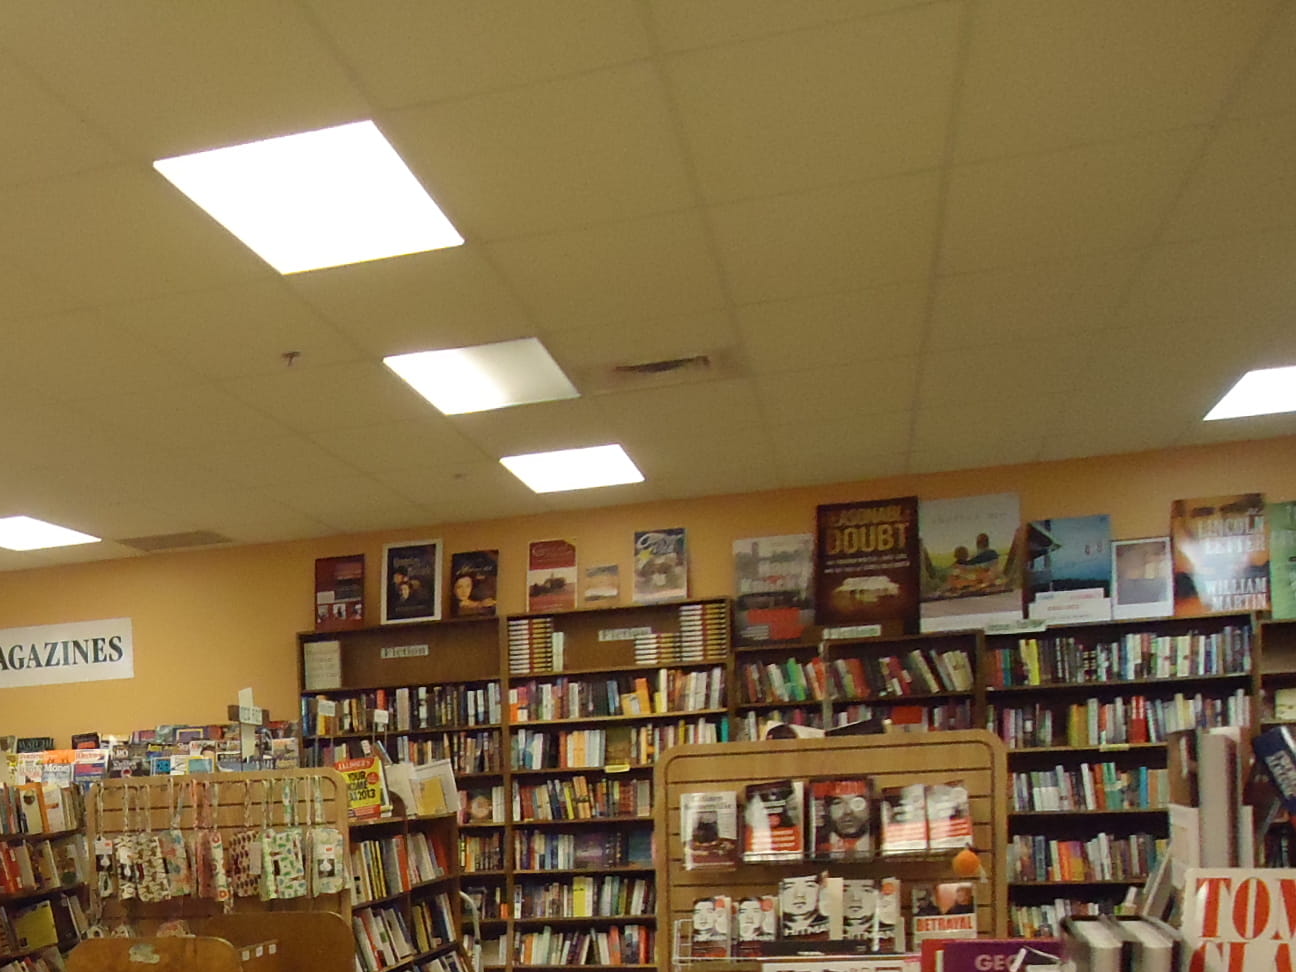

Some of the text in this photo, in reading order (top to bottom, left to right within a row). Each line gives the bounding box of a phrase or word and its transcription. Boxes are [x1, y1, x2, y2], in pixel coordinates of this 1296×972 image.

[826, 522, 910, 555] DOUBT
[383, 646, 427, 658] Fiction
[357, 788, 376, 801] 2013
[915, 915, 973, 932] BETRAYAL
